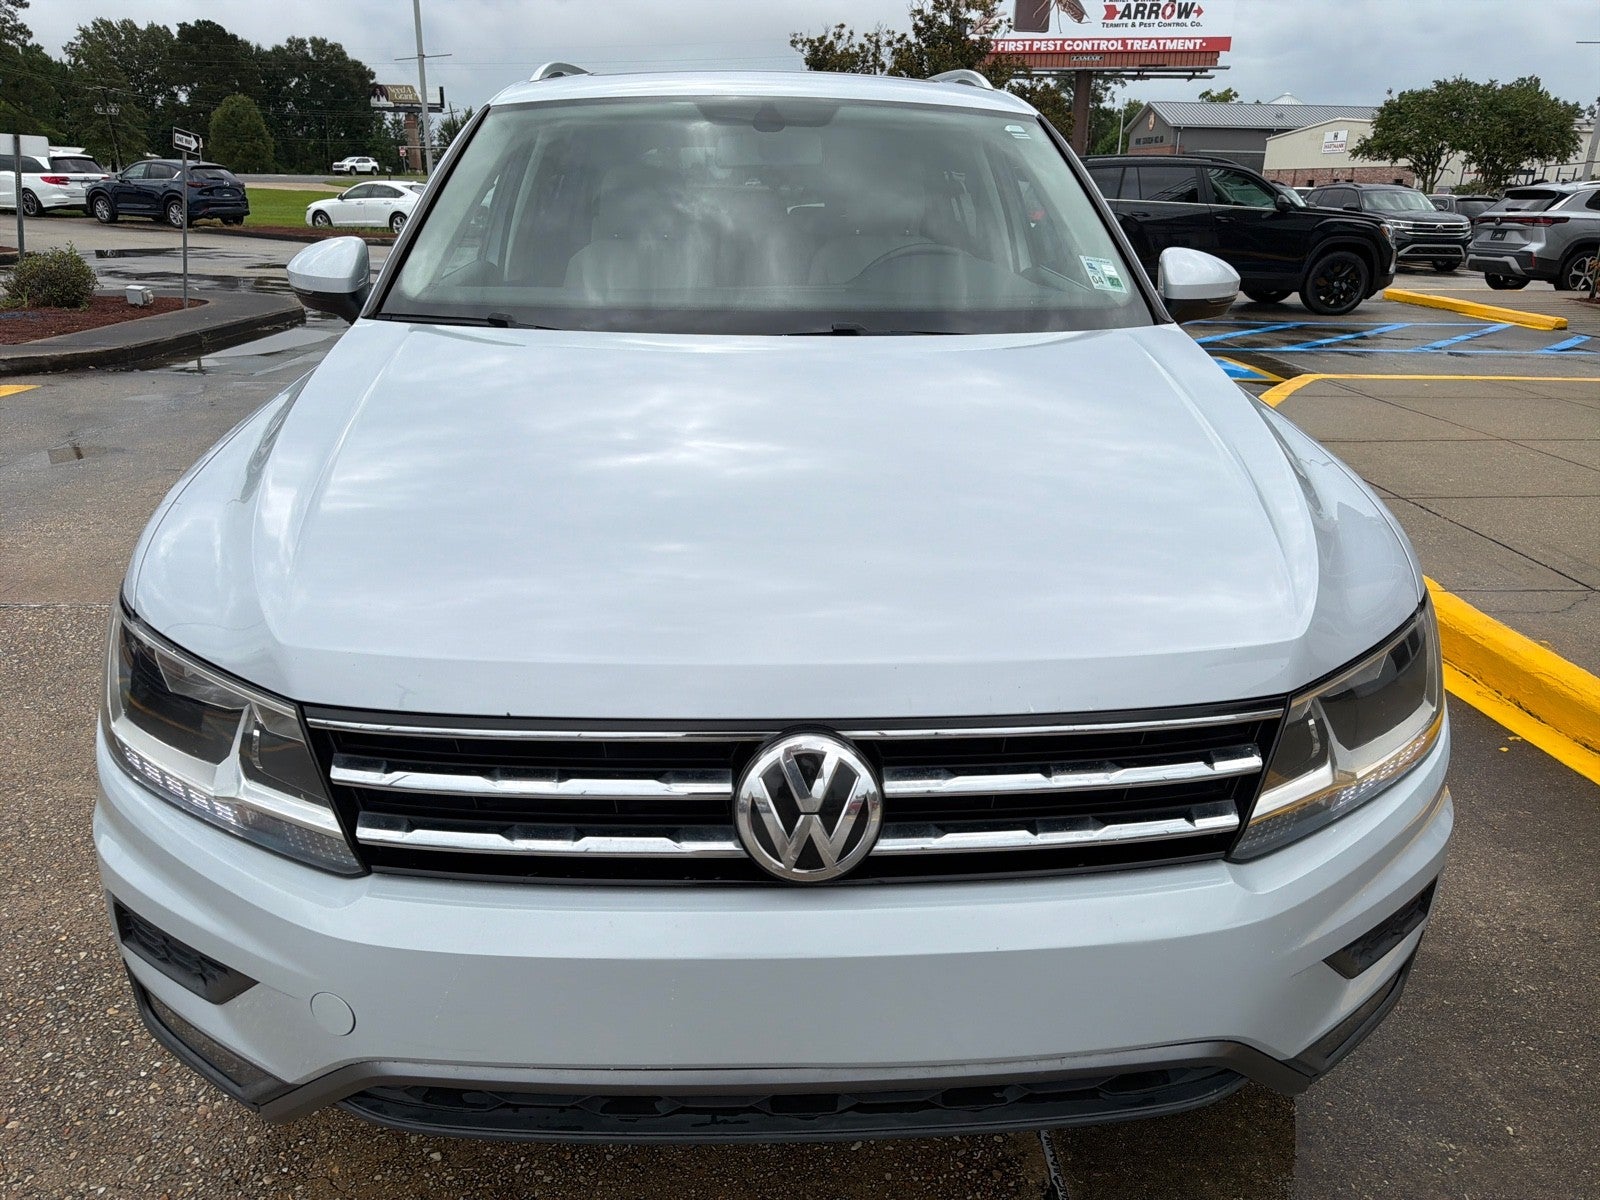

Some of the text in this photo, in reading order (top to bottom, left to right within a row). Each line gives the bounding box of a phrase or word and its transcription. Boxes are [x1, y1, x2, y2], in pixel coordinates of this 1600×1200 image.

[1118, 2, 1196, 20] ARROW
[997, 40, 1031, 51] FIRST
[1033, 40, 1063, 51] PEST
[1064, 39, 1125, 51] CONTROL
[176, 135, 193, 146] ONE WAY
